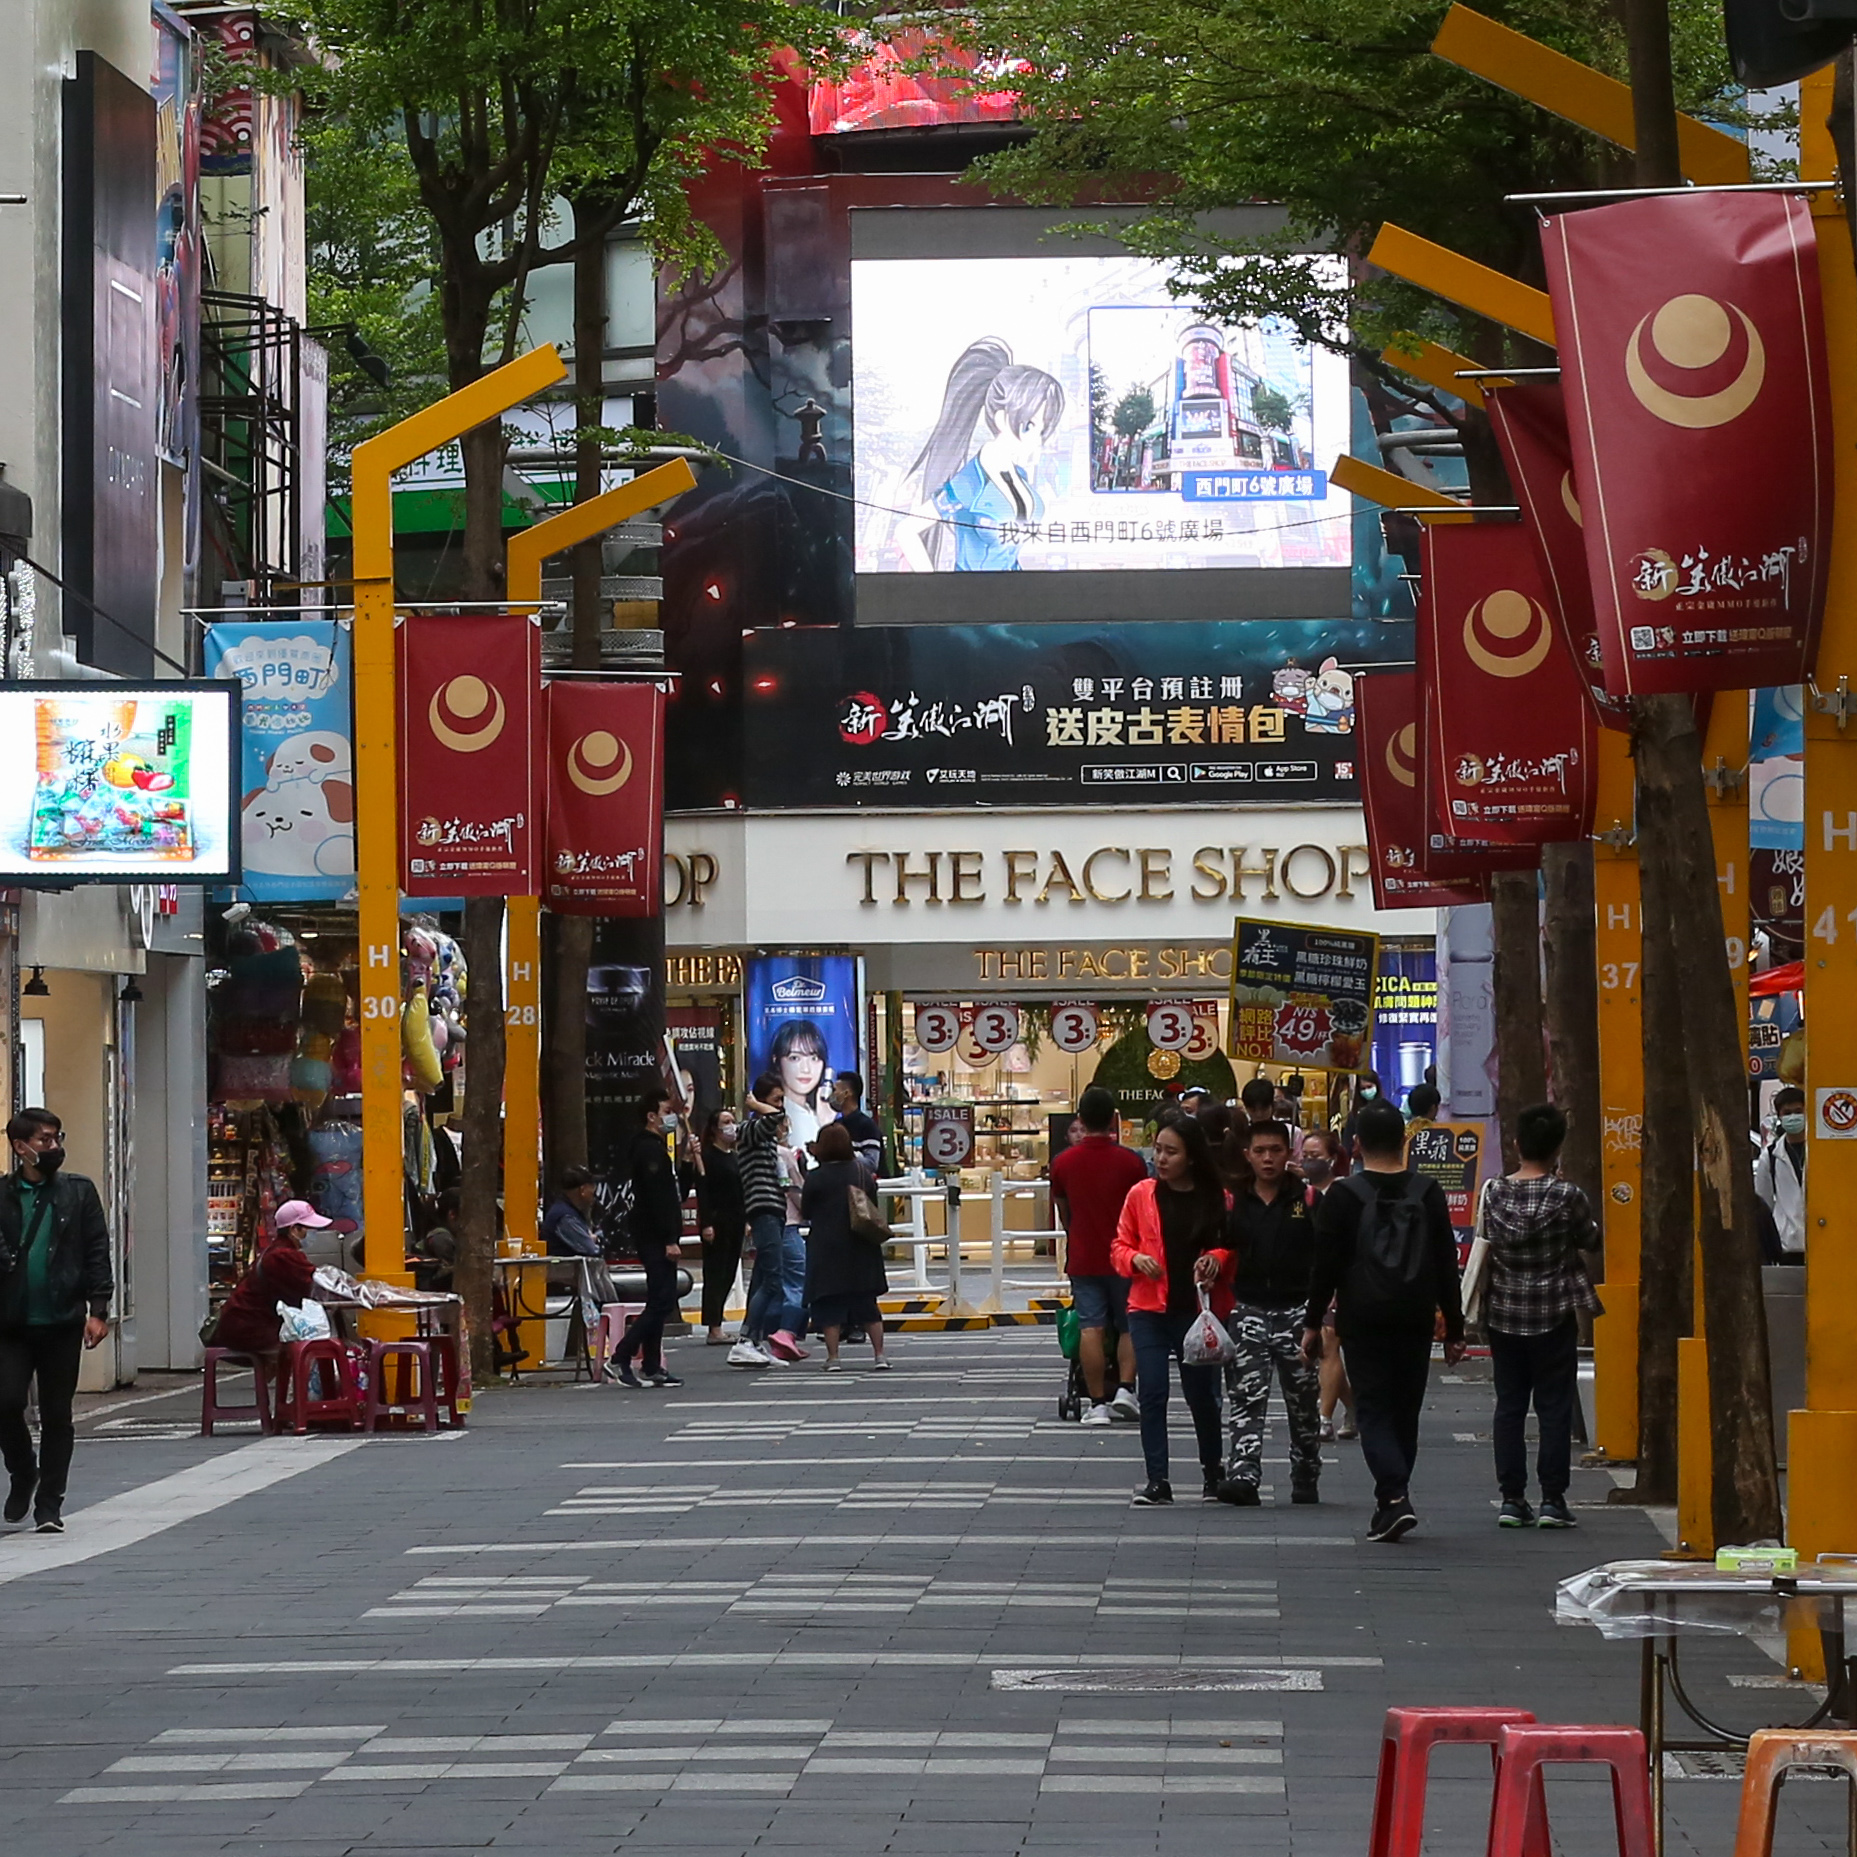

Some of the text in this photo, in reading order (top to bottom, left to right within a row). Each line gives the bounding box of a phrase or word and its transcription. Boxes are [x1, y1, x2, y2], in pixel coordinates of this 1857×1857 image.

[1195, 476, 1314, 497] 西門町6號廣場
[1072, 675, 1244, 702] 雙平台預註冊
[1045, 704, 1287, 748] 送皮古表情包
[1208, 770, 1250, 780] Google Play
[1823, 810, 1857, 851] H
[665, 851, 720, 907] OP
[846, 843, 1372, 906] THE FACE SHOP
[1607, 903, 1631, 930] H
[368, 944, 389, 969] H
[716, 954, 741, 985] FA
[973, 947, 1233, 982] THE FACE SHO
[513, 961, 530, 982] H
[1601, 962, 1641, 989] 37
[775, 985, 823, 999] Belmeur
[362, 995, 397, 1020] 30
[507, 1005, 536, 1026] 28
[607, 1051, 655, 1067] Miracle
[1118, 1089, 1165, 1101] THE FAC
